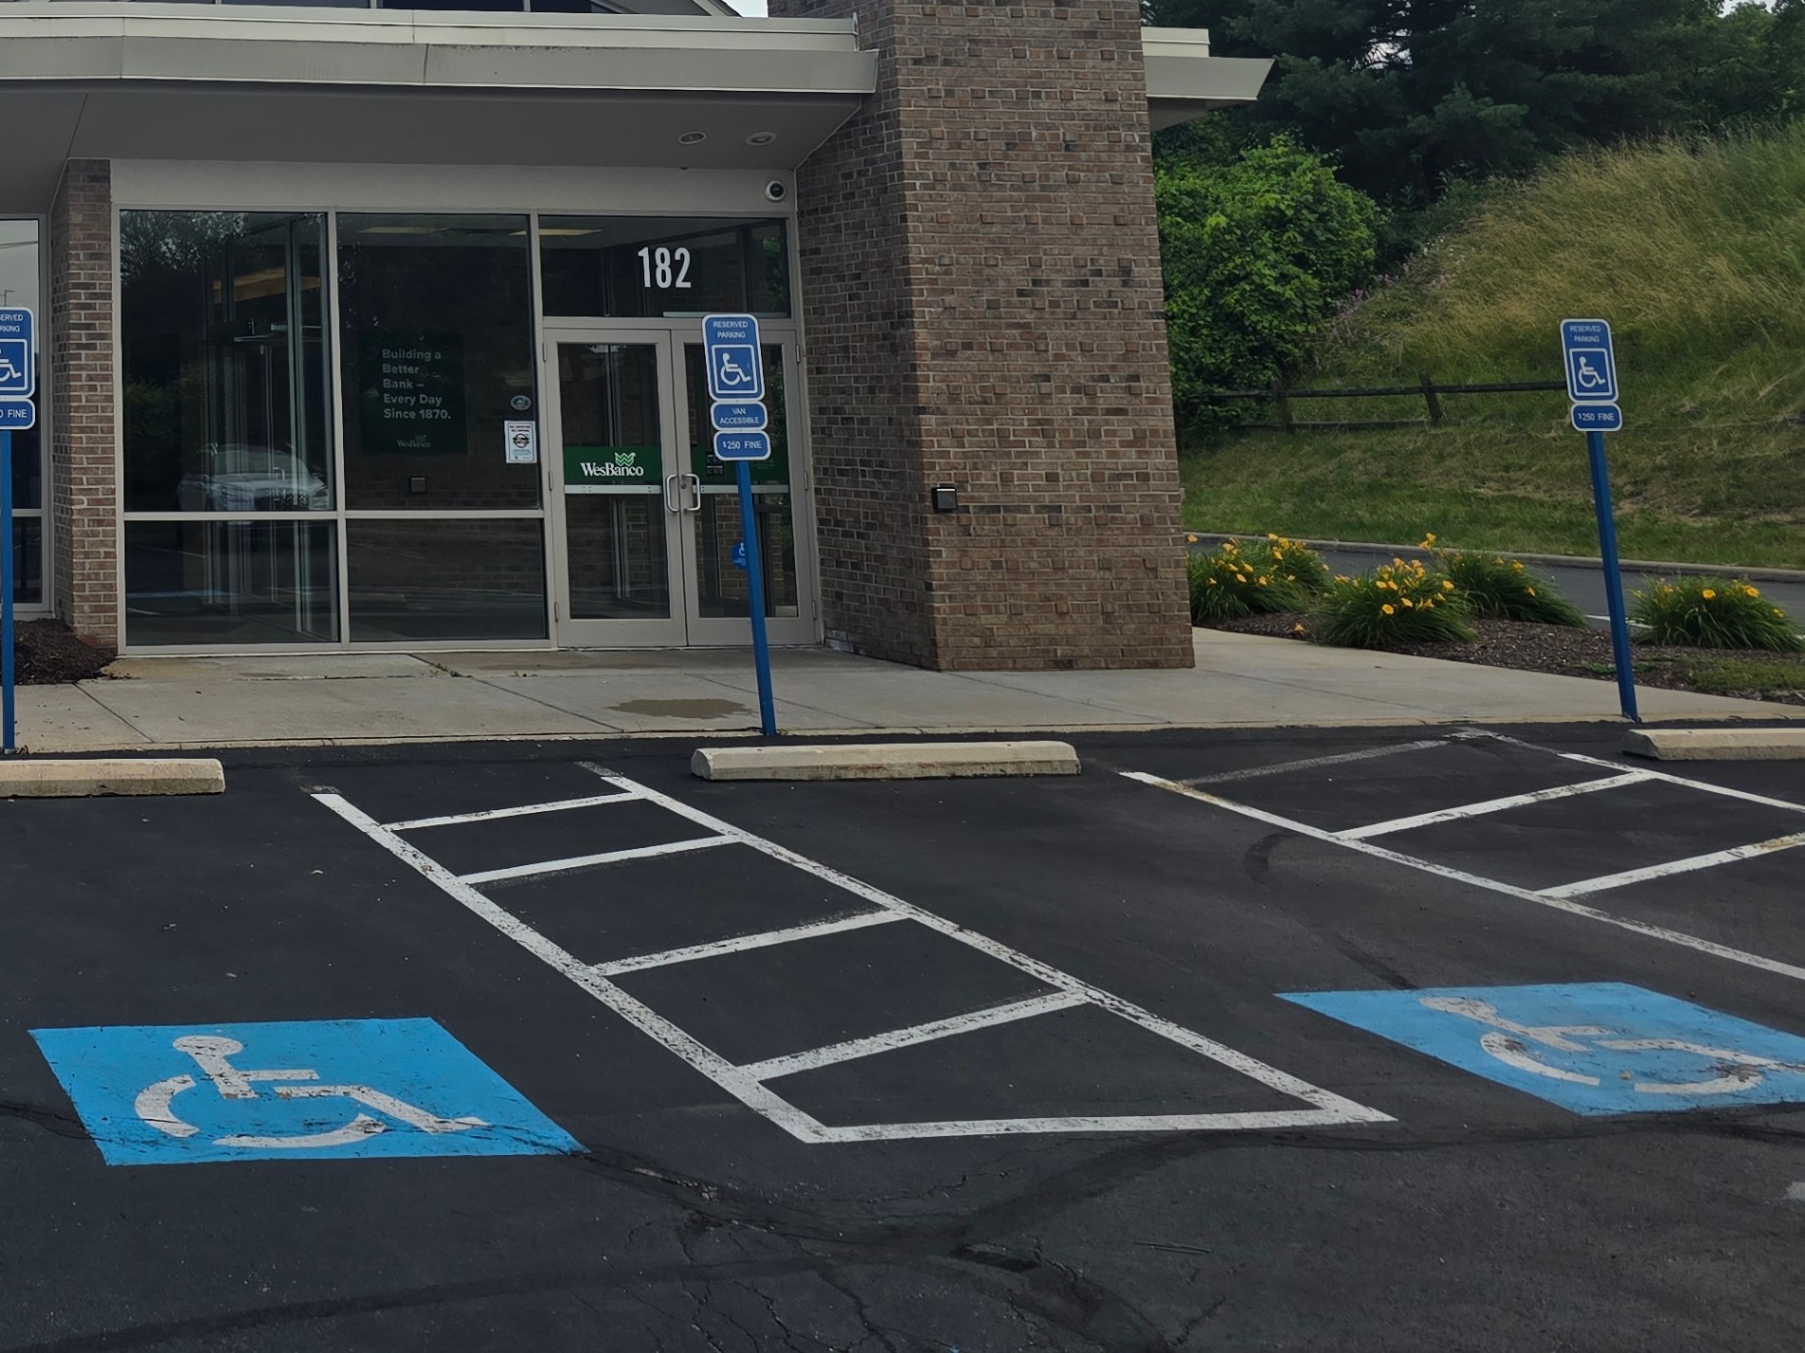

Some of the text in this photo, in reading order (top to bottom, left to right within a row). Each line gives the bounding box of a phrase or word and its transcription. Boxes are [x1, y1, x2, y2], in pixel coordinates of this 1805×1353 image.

[637, 246, 692, 288] 182
[1569, 325, 1602, 333] RESERVED
[717, 331, 746, 339] PARKING
[1573, 335, 1600, 343] PARKING
[382, 348, 431, 362] Building
[382, 364, 420, 374] Better
[383, 379, 413, 389] Bank
[383, 393, 442, 406] Every Day
[7, 409, 27, 418] FINE
[383, 408, 451, 419] Since 1870.
[731, 407, 746, 415] VAN
[719, 416, 760, 425] ACCESSIBLE
[1577, 412, 1615, 421] $250 FINE
[722, 440, 762, 449] $250 FINE
[580, 462, 644, 476] WesBanco
